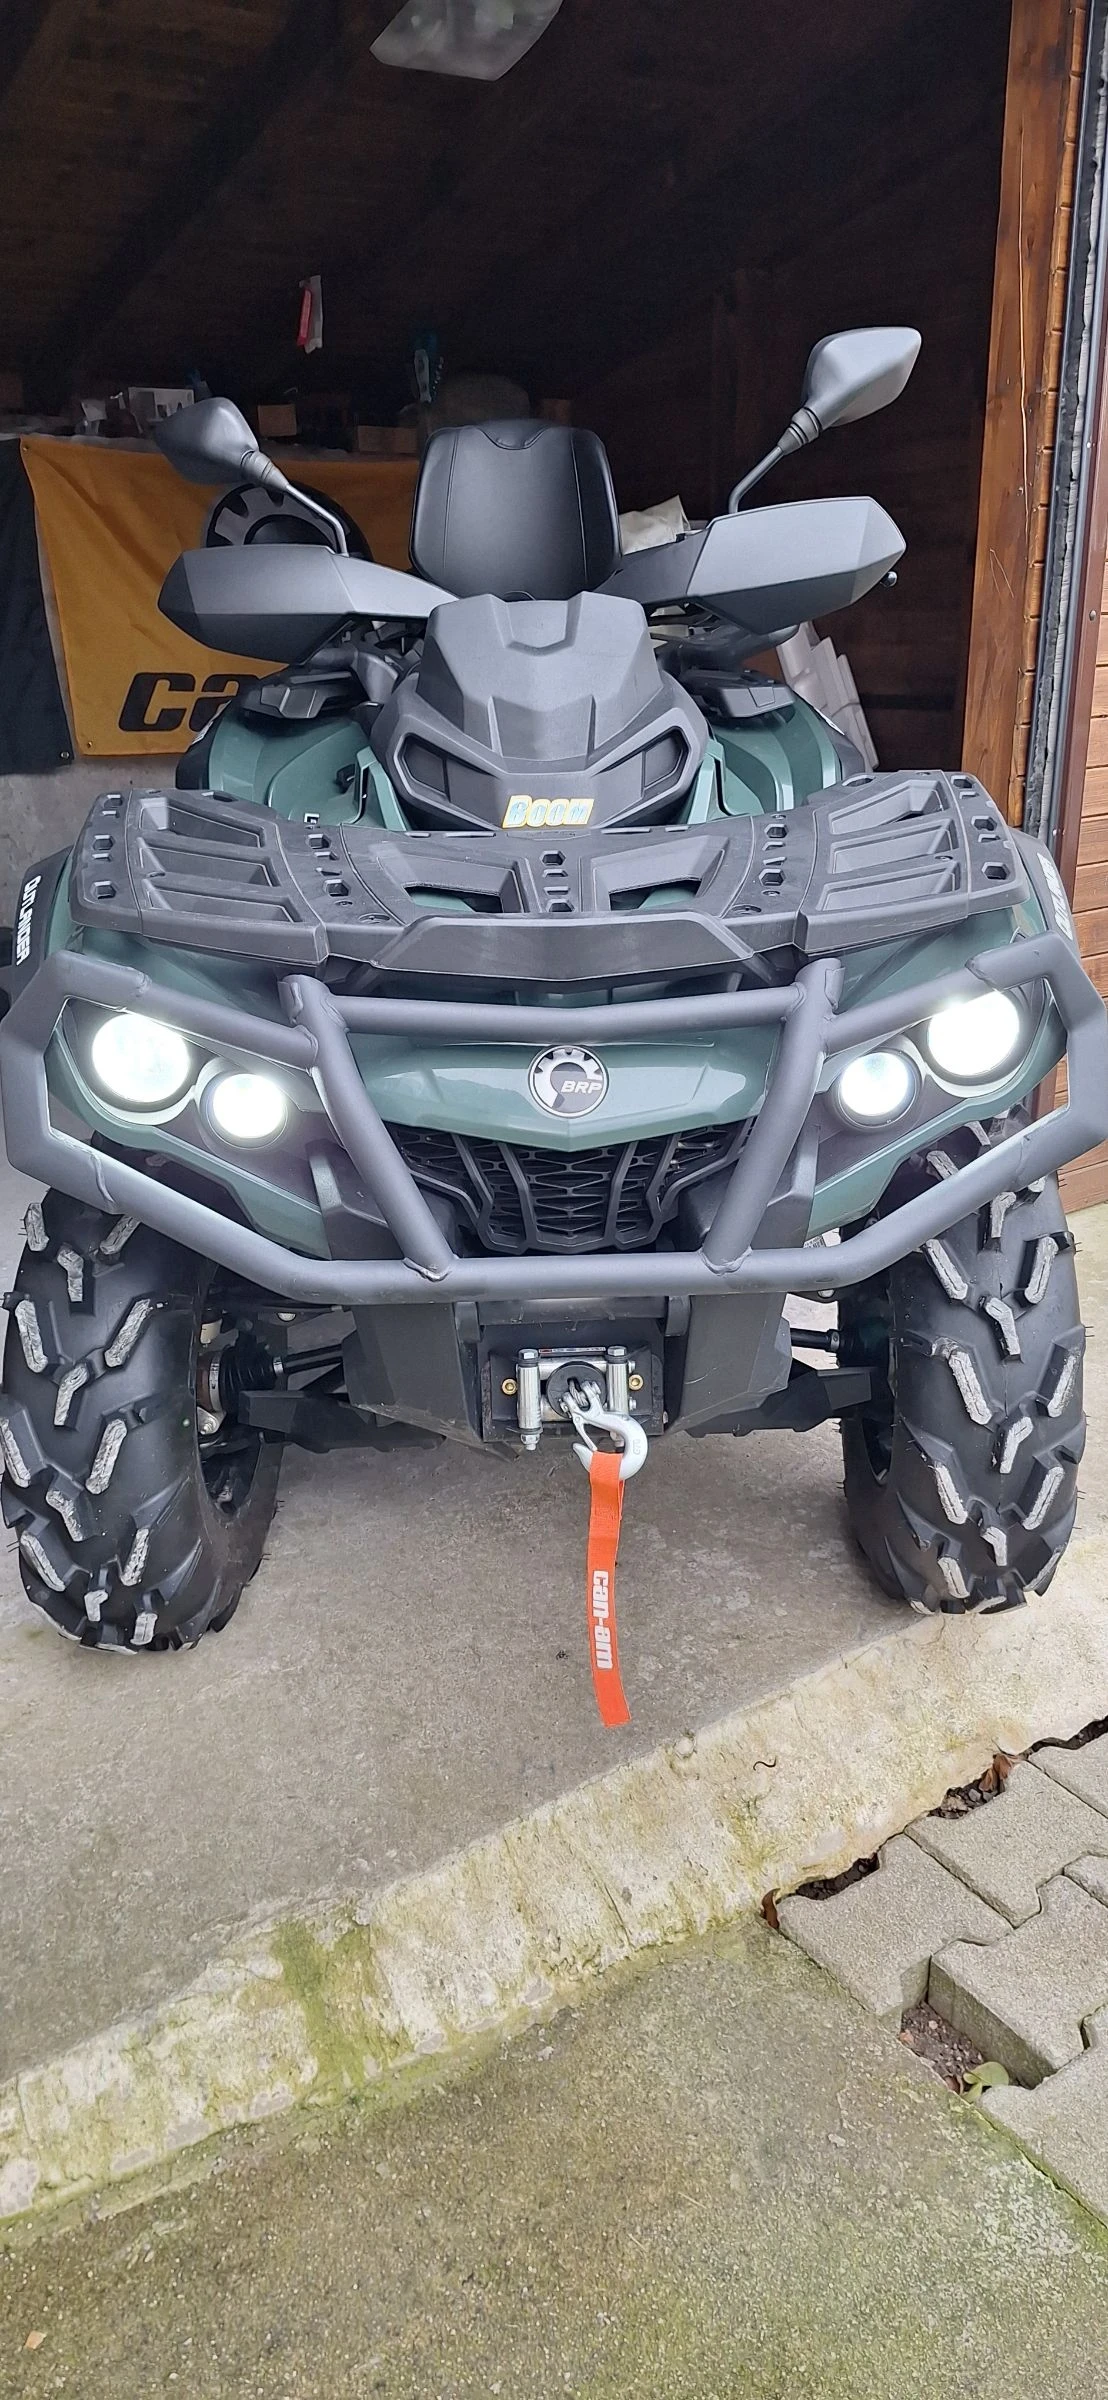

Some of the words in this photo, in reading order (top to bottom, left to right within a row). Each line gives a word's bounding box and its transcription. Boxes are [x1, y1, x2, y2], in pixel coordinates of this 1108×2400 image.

[16, 875, 42, 966] OUTLANDER
[560, 1080, 602, 1094] BRP
[592, 1570, 613, 1669] can-am
